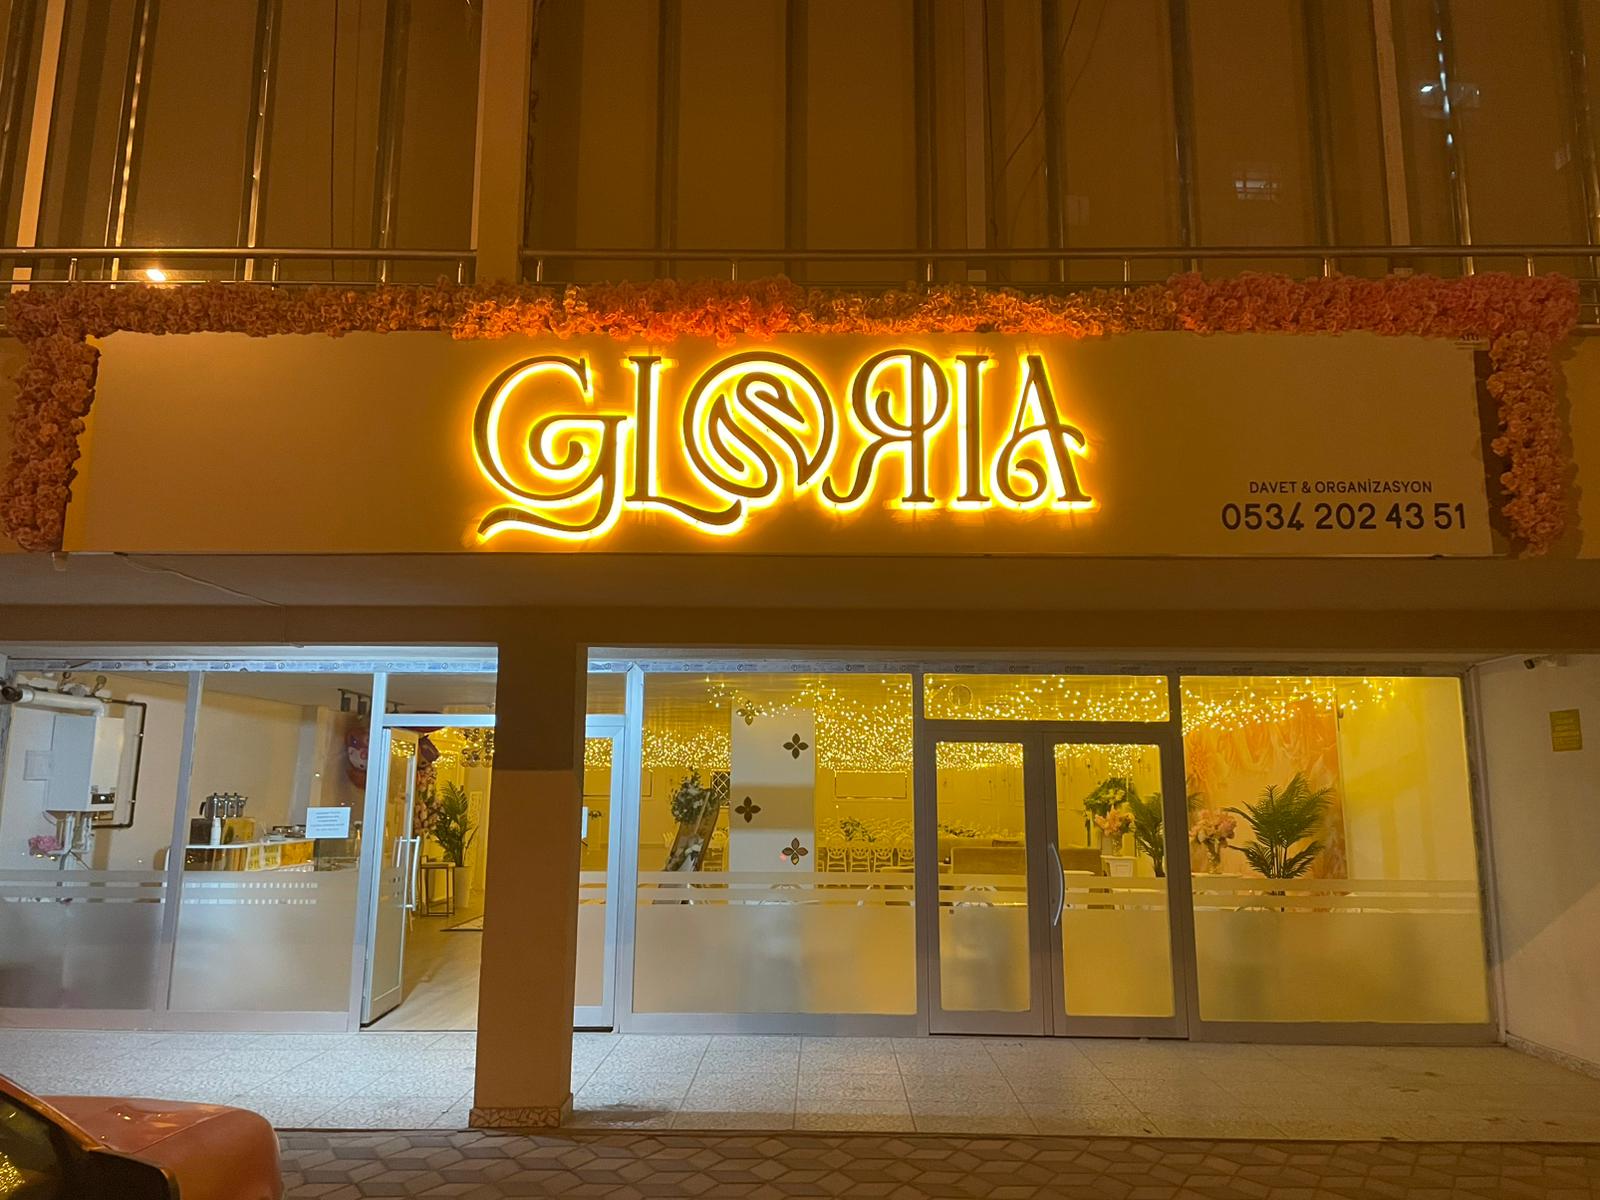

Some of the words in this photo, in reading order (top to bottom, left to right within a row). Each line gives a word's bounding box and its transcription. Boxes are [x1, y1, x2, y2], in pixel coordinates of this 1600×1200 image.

[473, 348, 1093, 539] GLORIA
[1249, 481, 1297, 493] DAVET
[1301, 481, 1311, 493] &
[1314, 478, 1433, 493] ORGANİZASYON
[1221, 502, 1304, 531] 0534
[1314, 502, 1377, 530] 202
[1385, 502, 1425, 530] 43
[1433, 502, 1466, 530] 51
